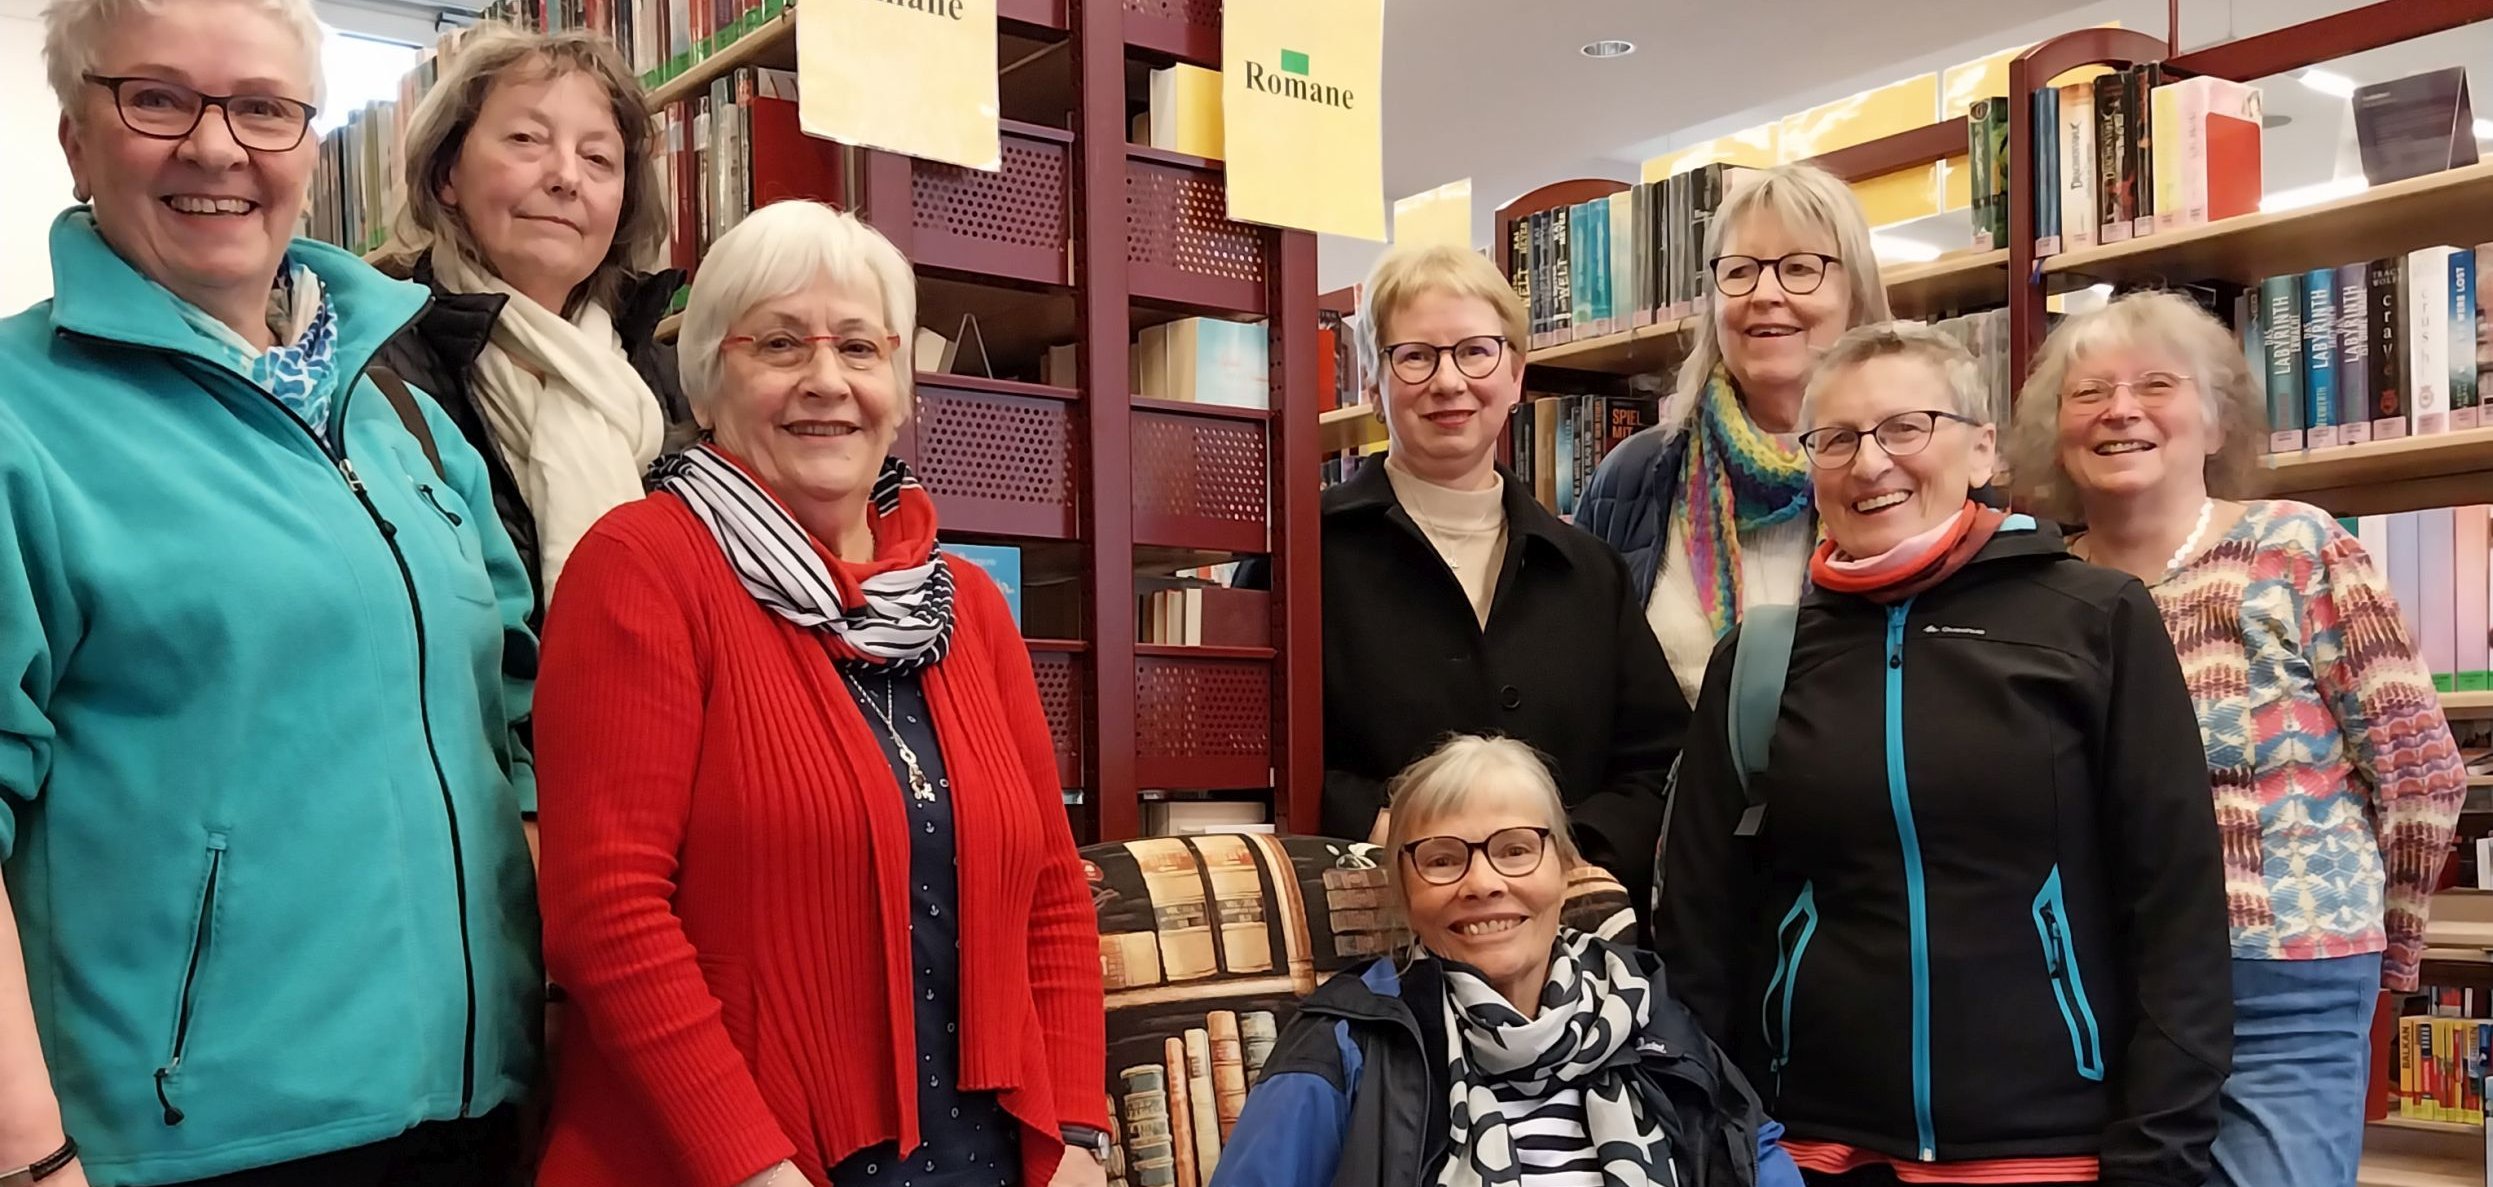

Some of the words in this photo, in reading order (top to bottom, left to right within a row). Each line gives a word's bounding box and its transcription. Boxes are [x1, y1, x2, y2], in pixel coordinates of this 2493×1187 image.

[876, 0, 963, 20] ane
[1244, 60, 1354, 110] Romane
[1519, 221, 1528, 254] MEYER
[1557, 258, 1571, 300] WELT
[2456, 267, 2465, 292] LOST
[2264, 330, 2274, 347] DAS
[2273, 296, 2290, 375] LABYRINTH
[2311, 289, 2329, 369] LABYRINTH
[2343, 285, 2359, 363] LABYRINTH
[2382, 294, 2392, 375] crave
[1612, 408, 1642, 426] SPIEL
[1612, 425, 1633, 438] MIT
[2402, 1026, 2410, 1069] BALKAN
